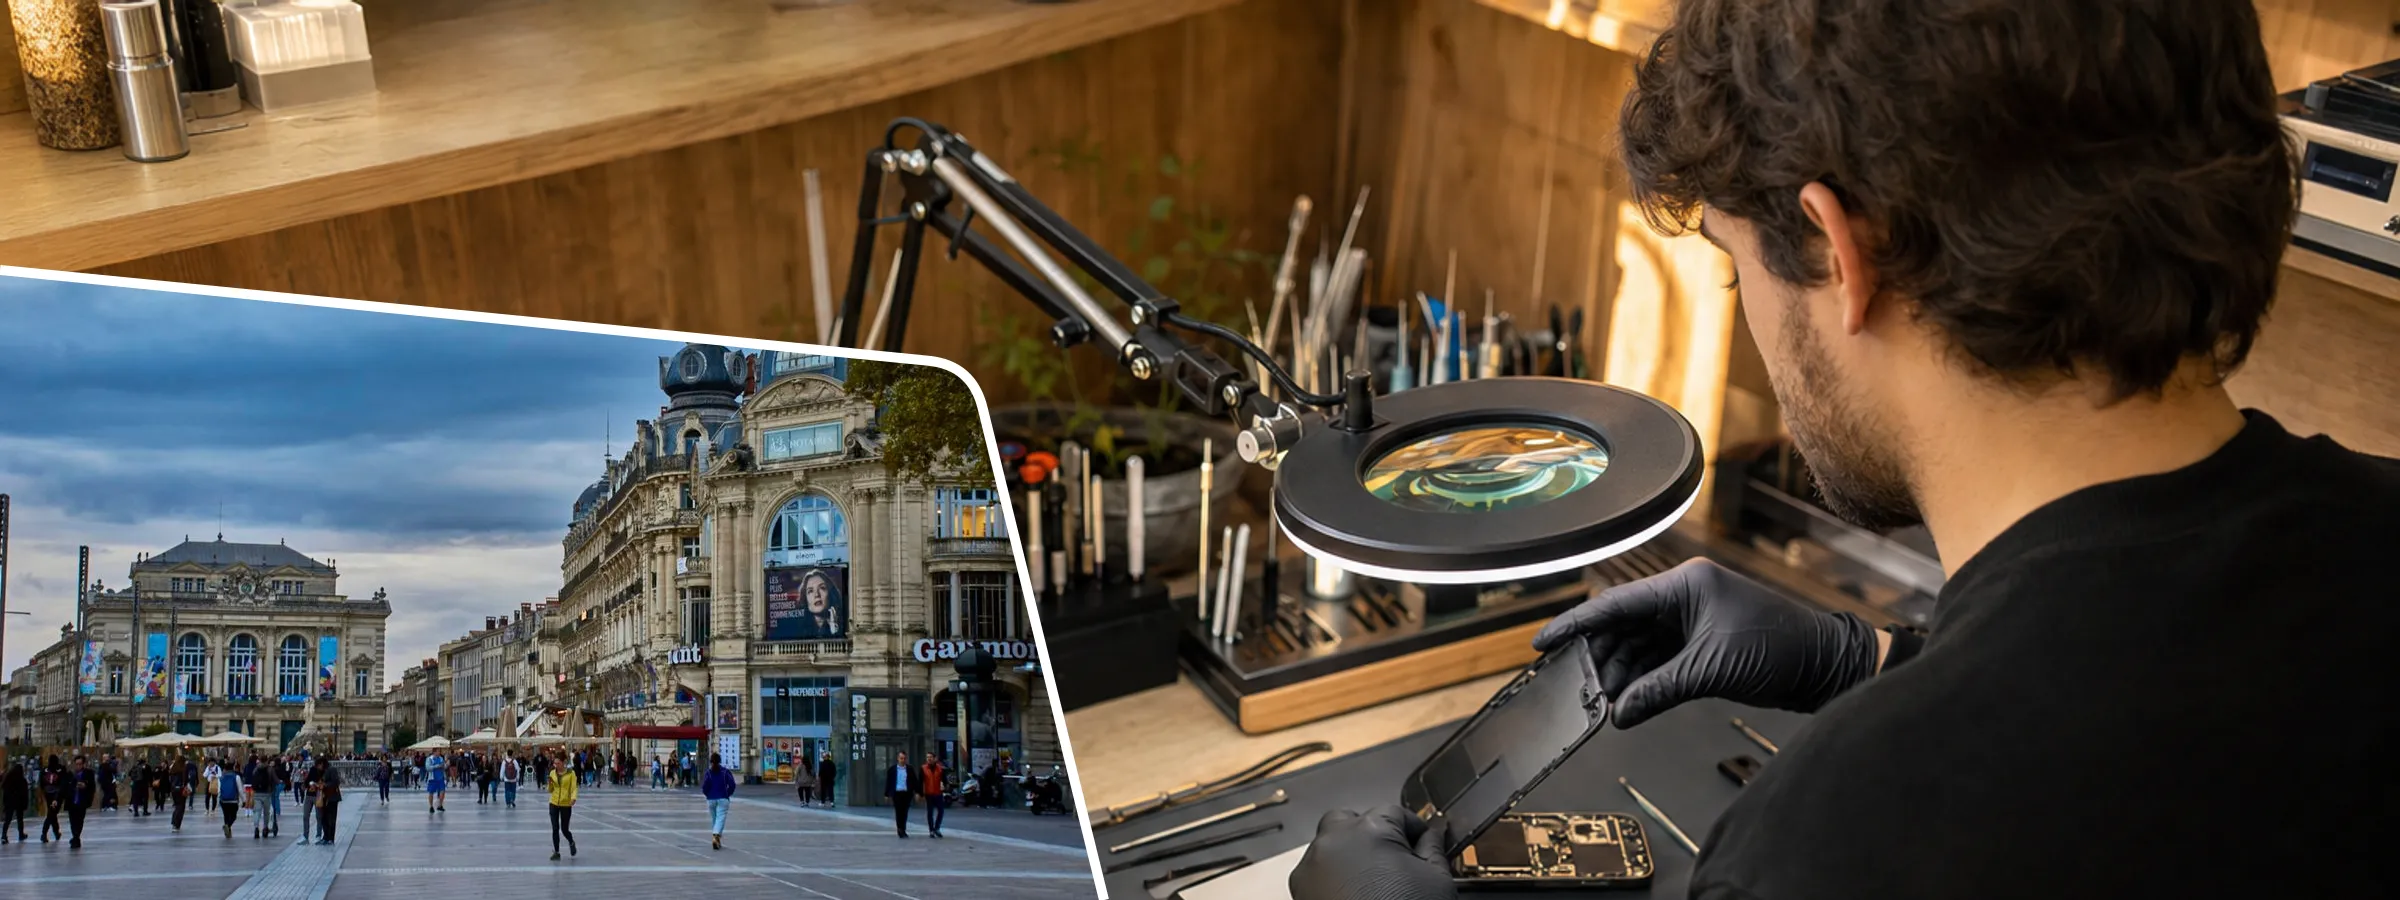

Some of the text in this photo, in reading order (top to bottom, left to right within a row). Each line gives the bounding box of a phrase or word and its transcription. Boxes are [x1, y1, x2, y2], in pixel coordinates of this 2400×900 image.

[769, 576, 779, 584] LES
[769, 584, 783, 593] PLUS
[769, 593, 788, 602] BELLES
[769, 601, 796, 610] HISTOIRES
[769, 609, 805, 619] COMMENCENT
